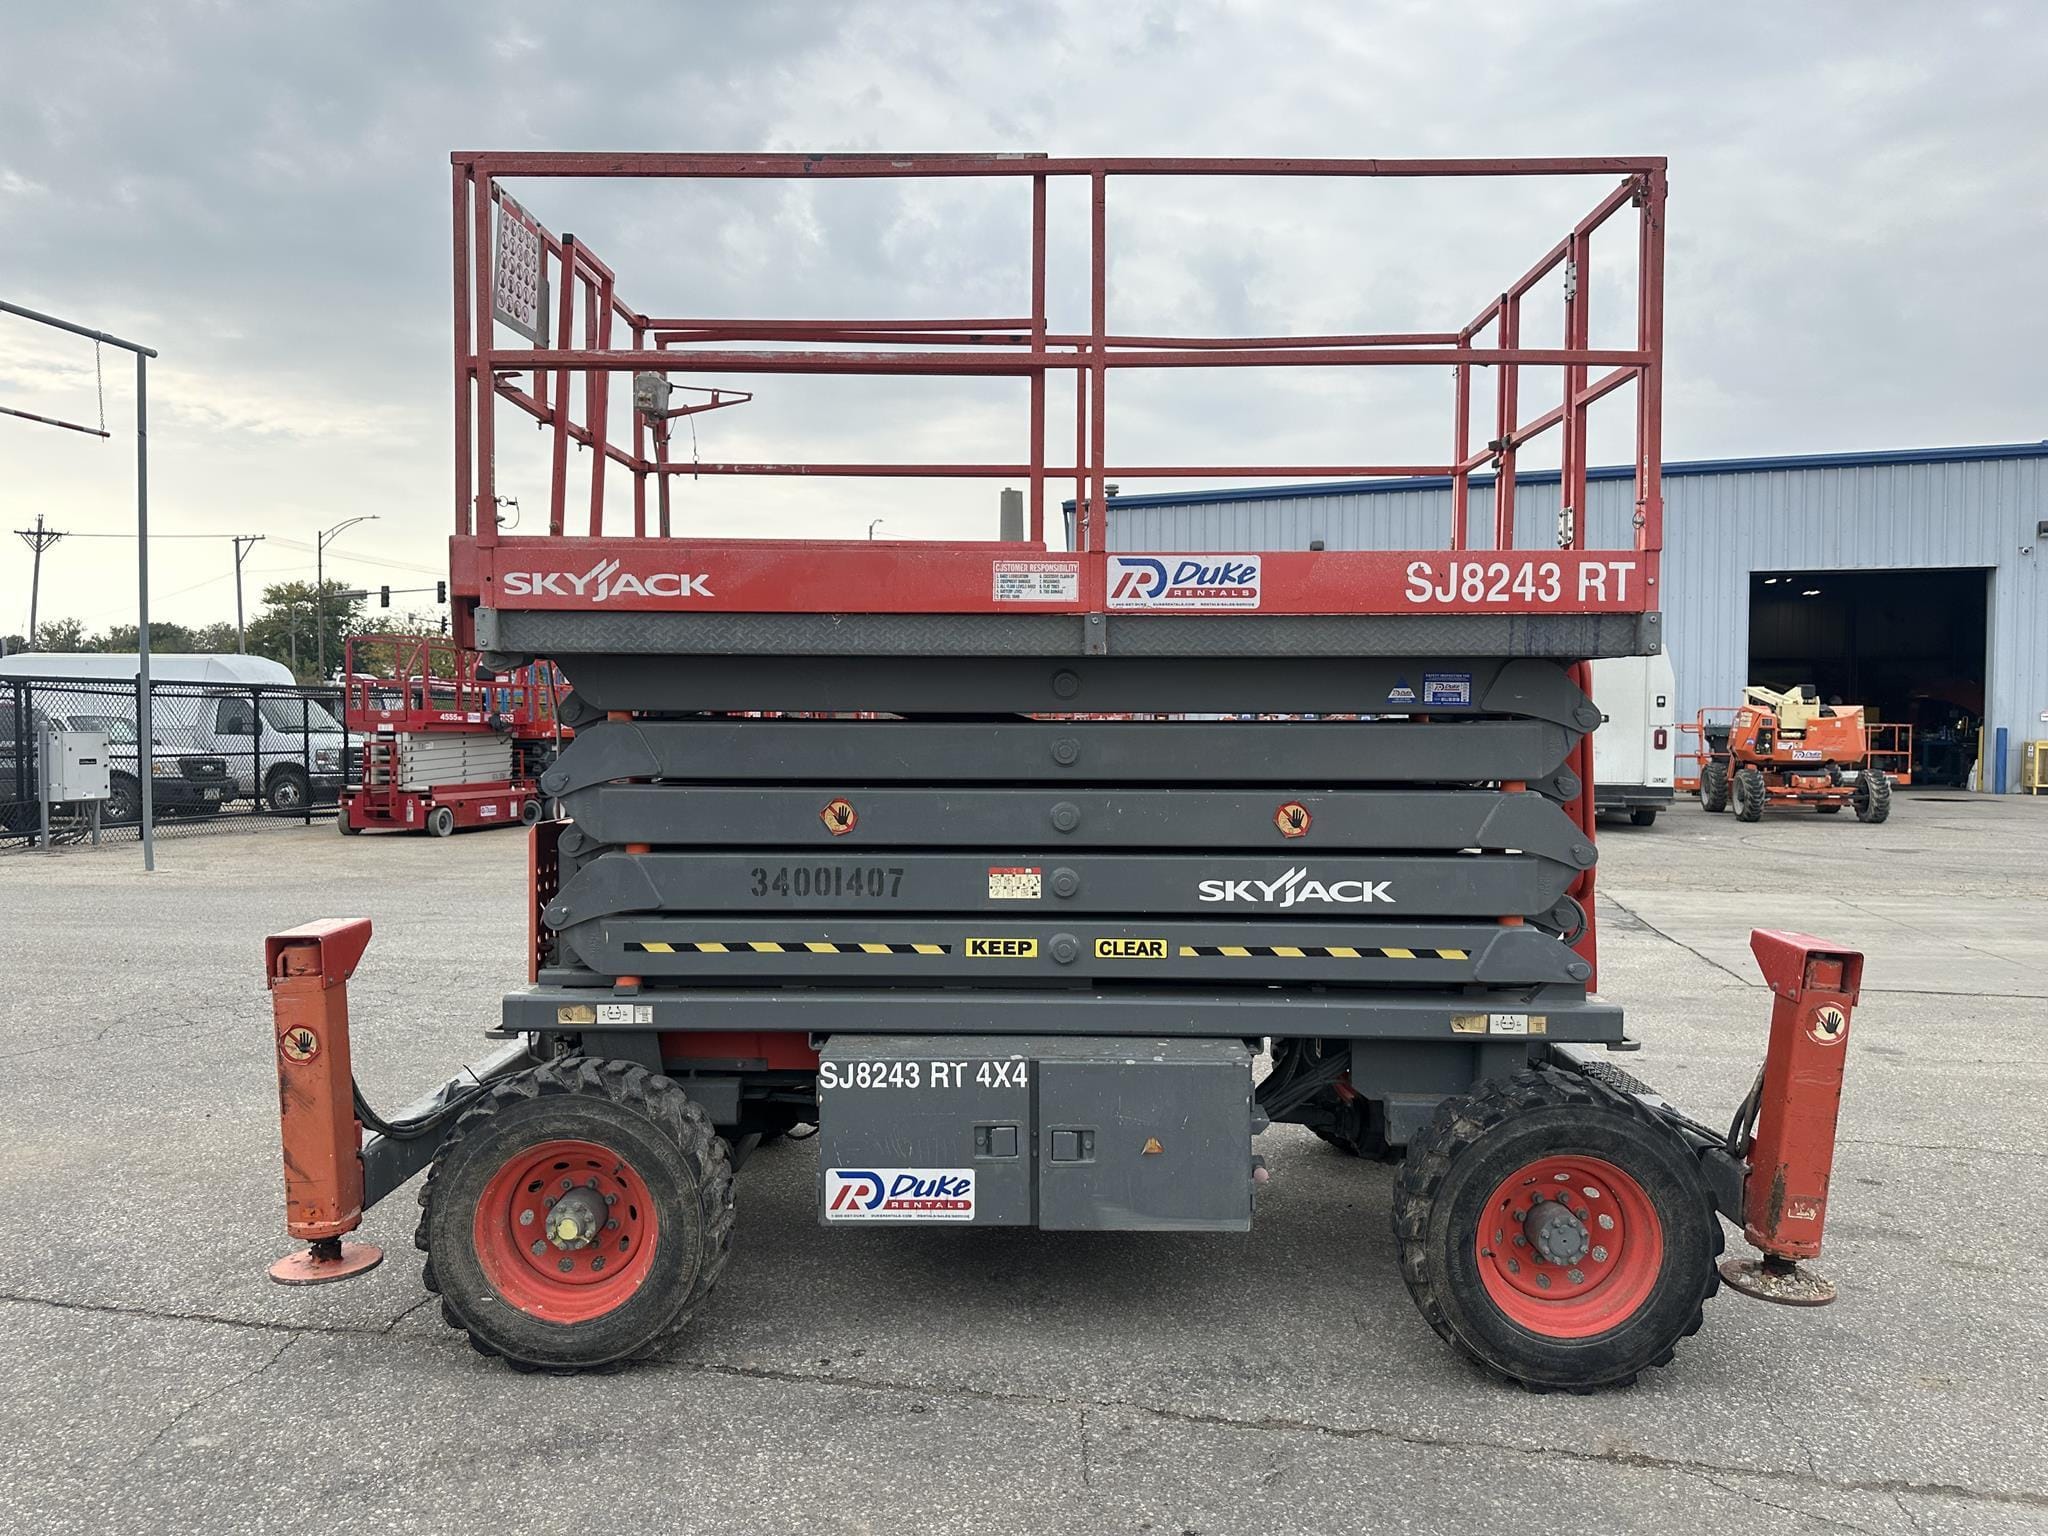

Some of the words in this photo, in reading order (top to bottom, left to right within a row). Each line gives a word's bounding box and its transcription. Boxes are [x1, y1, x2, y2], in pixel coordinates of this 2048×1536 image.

[503, 558, 715, 602] SKYJACK
[995, 563, 1028, 572] CUSTOMER
[1029, 563, 1078, 572] RESPONSIBILITY
[1173, 589, 1250, 597] RENTALS
[1405, 561, 1561, 603] SJ8243
[1578, 561, 1636, 602] RT
[751, 866, 904, 898] 34001407
[1198, 866, 1397, 908] SKYJACK
[971, 940, 1033, 955] KEEP
[1099, 940, 1163, 956] CLEAR
[819, 1061, 921, 1089] SJ8243
[930, 1061, 968, 1089] RT
[976, 1061, 1028, 1089] 4X4
[891, 1201, 966, 1209] RENTALS
